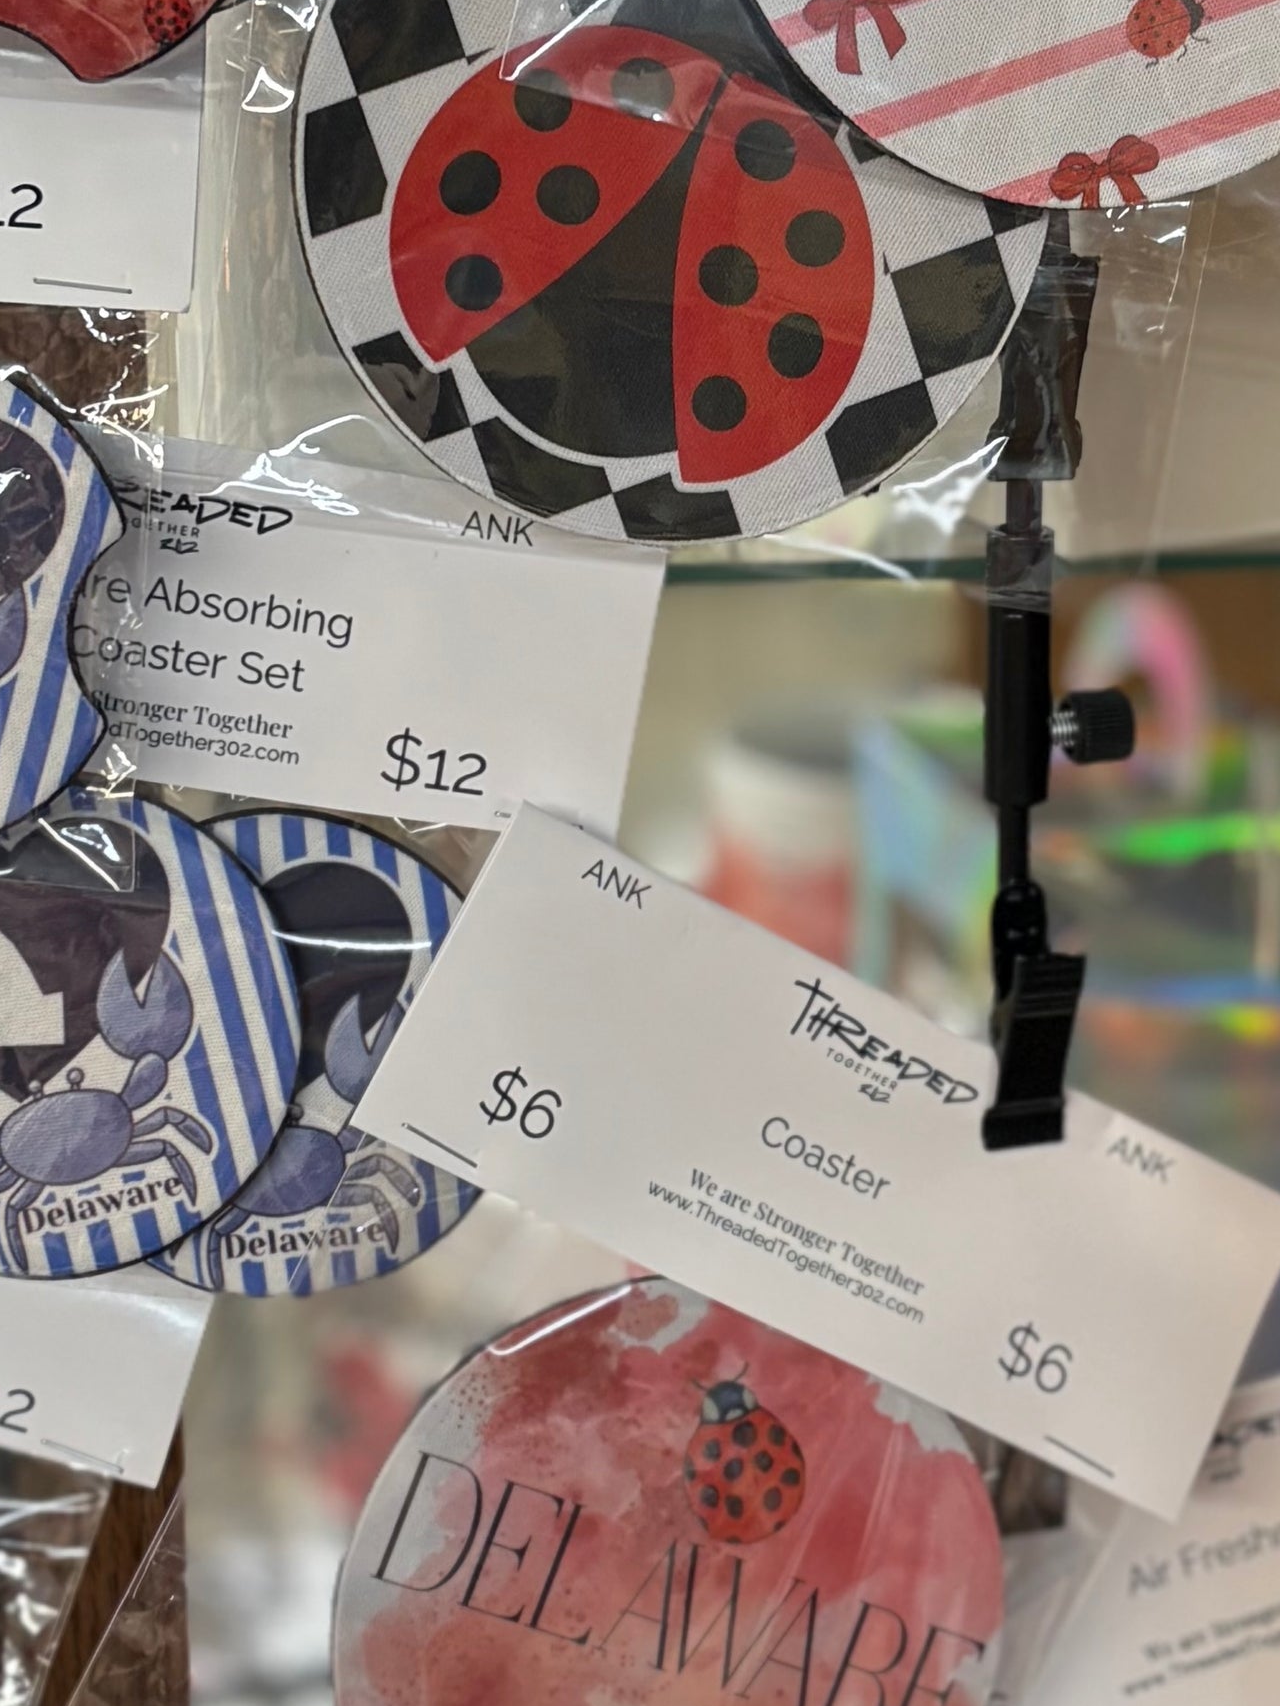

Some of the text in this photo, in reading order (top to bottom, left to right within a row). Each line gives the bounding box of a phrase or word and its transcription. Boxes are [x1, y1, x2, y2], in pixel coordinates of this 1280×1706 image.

[460, 510, 536, 548] ANK
[144, 576, 354, 649] Absorbing
[72, 624, 305, 694] Coaster Set
[192, 704, 295, 739] Together
[381, 727, 487, 796] $12
[581, 859, 653, 910] ANK
[789, 977, 980, 1105] THREADED
[825, 1045, 900, 1091] TOGETHER
[478, 1066, 563, 1140] $6
[761, 1116, 892, 1201] Coaster
[1106, 1134, 1176, 1185] ANK
[22, 1172, 184, 1235] Delaware
[689, 1167, 926, 1297] We are Stronger Together
[224, 1219, 388, 1262] Delaware
[647, 1179, 926, 1324] www.ThreadedTogether302.com
[997, 1321, 1075, 1394] $6
